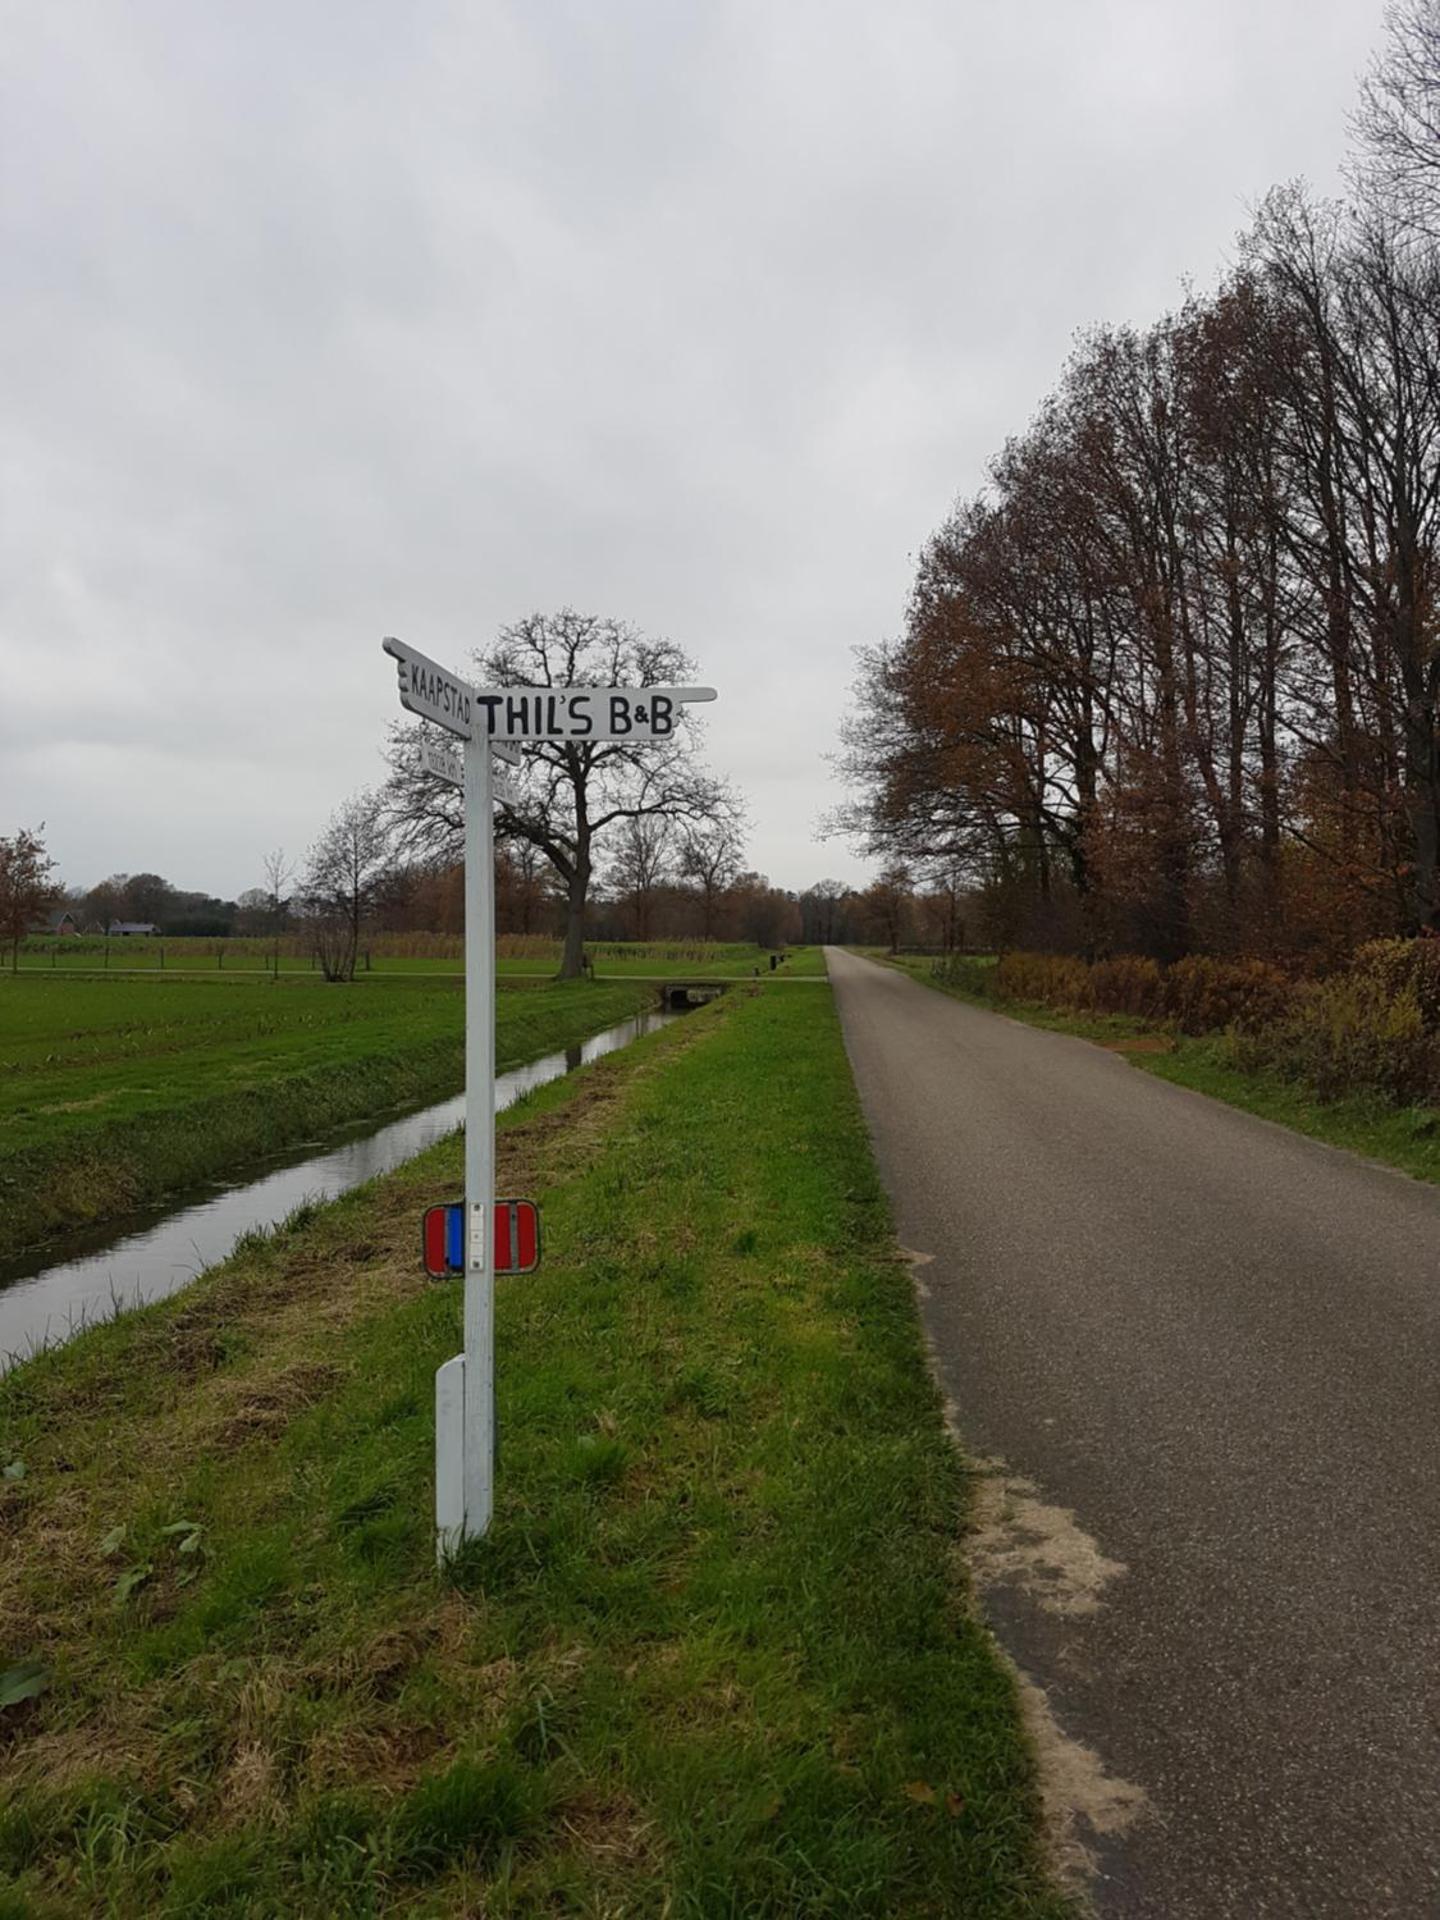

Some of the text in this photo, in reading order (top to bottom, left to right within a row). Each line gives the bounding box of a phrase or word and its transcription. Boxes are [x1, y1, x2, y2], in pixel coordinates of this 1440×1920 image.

[411, 664, 471, 725] KAAPSTAD
[477, 695, 673, 735] THIL'S B&B
